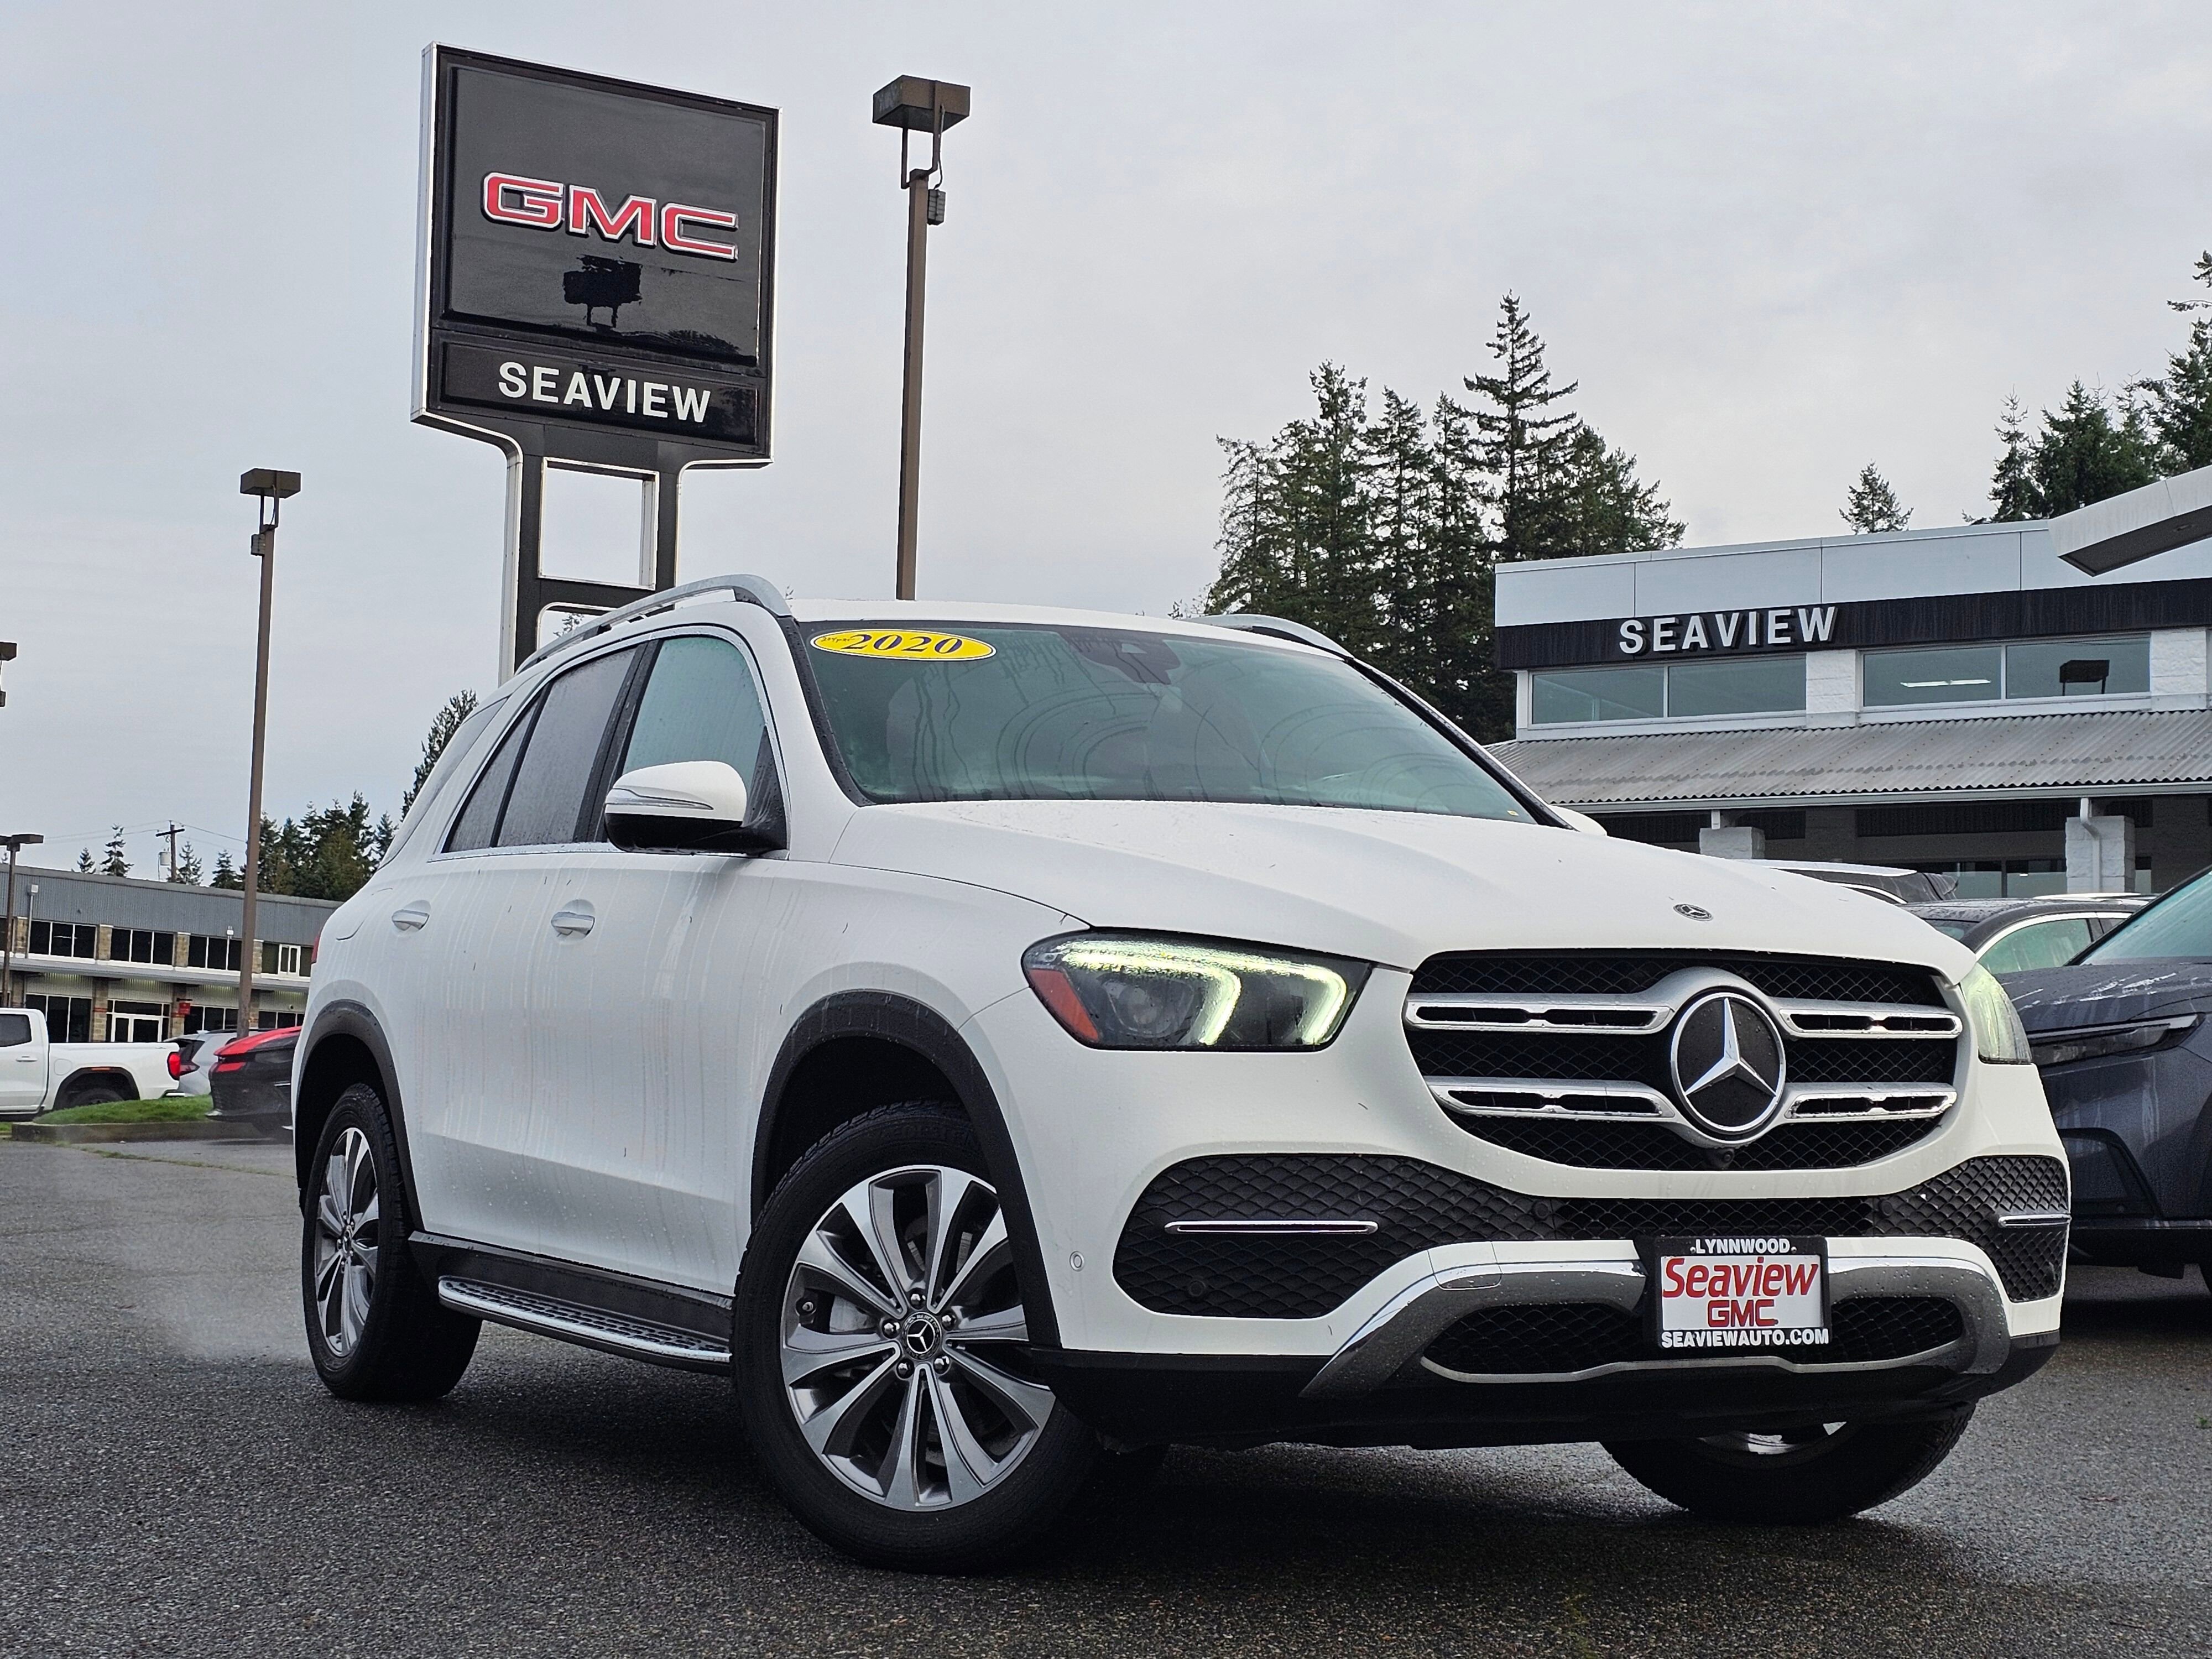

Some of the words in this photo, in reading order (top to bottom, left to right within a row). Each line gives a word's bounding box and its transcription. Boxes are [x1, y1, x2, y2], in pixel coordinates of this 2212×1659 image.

[483, 172, 739, 260] GMC
[498, 362, 711, 422] SEAVIEW
[841, 634, 963, 654] 2020
[1619, 607, 1835, 654] SEAVIEW
[1695, 1238, 1790, 1254] LYNNWOOD
[1662, 1256, 1819, 1298] Seaview
[1708, 1299, 1778, 1328] GMC
[1661, 1328, 1829, 1348] SEAVIEWAUTO.COM
